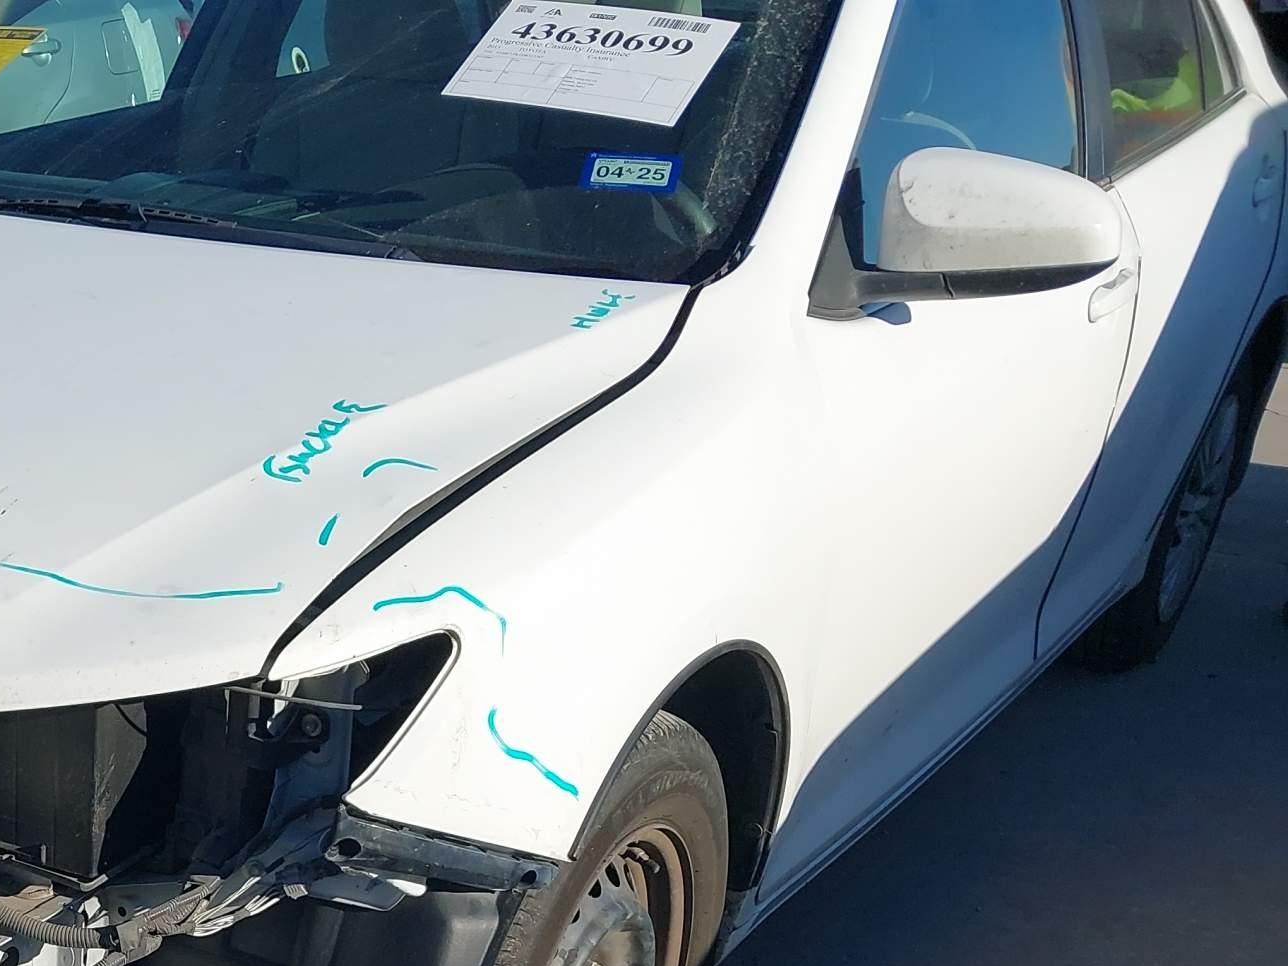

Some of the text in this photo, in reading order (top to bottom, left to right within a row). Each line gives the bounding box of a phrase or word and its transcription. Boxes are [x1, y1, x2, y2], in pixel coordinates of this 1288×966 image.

[491, 37, 631, 58] Progressive Casualty Insurance
[511, 21, 694, 56] 43630699
[596, 165, 666, 181] 04 25
